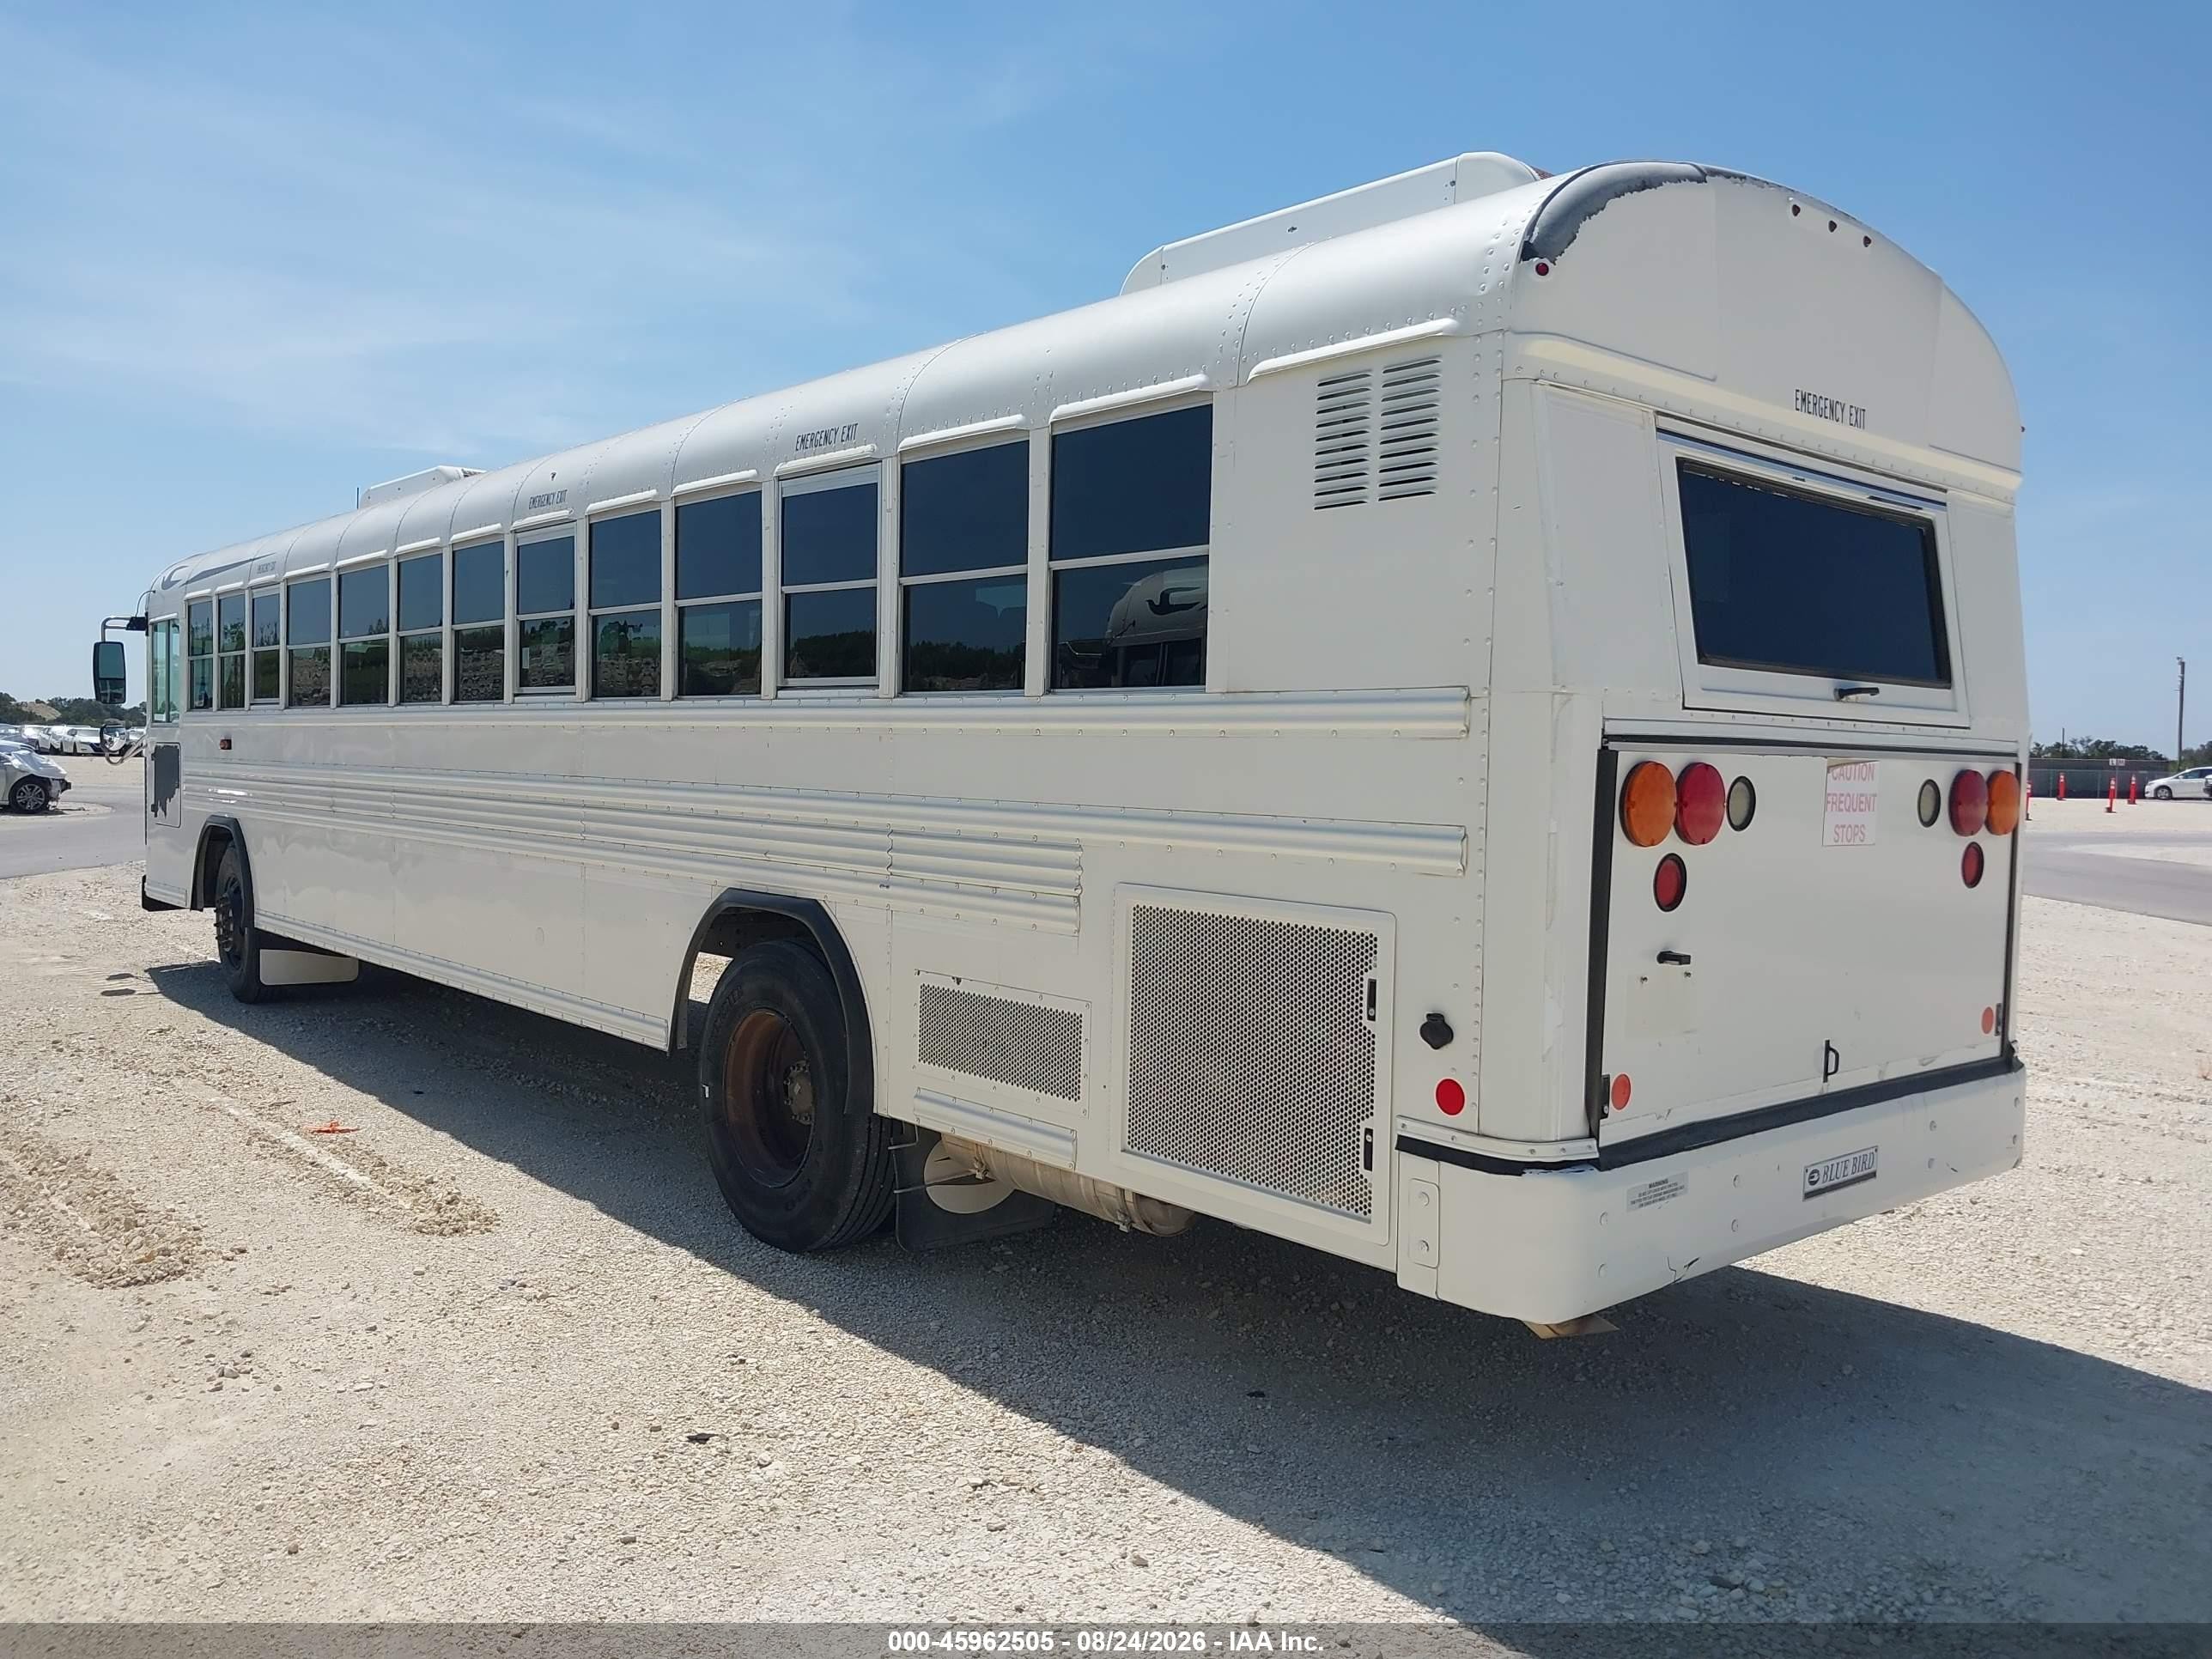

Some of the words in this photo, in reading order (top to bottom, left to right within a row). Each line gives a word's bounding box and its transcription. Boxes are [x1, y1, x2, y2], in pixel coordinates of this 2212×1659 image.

[1795, 389, 1845, 424] EMERGENCY
[1849, 404, 1866, 430] EXIT
[795, 427, 840, 452] EMERGENCY
[841, 422, 859, 443] EXIT
[528, 492, 556, 510] EMERGENCY
[556, 489, 568, 504] EXIT
[1831, 763, 1875, 781] CAUTION
[1826, 792, 1877, 812] FREQUENT
[1833, 823, 1866, 843] STOPS
[1821, 1158, 1850, 1184] BLUE
[1851, 1152, 1875, 1176] BIRD
